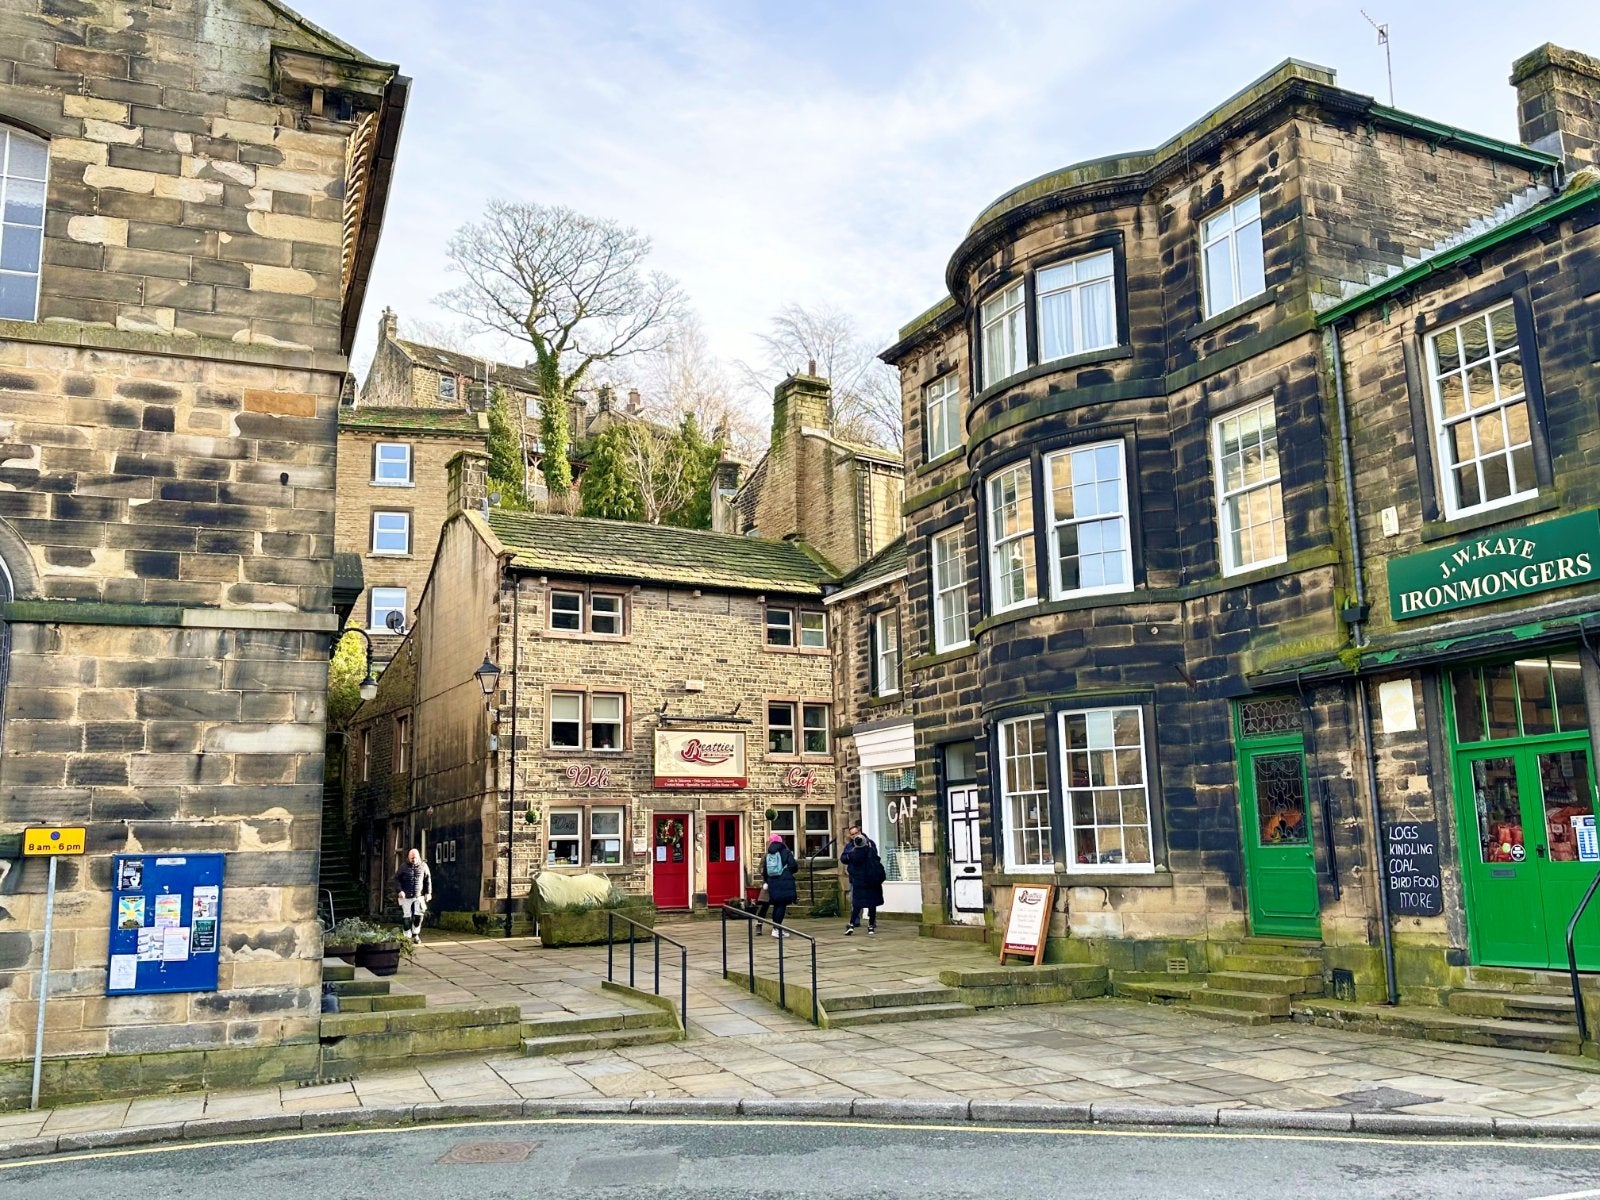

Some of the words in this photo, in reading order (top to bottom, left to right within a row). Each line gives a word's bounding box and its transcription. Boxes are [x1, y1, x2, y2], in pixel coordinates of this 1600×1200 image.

[1400, 553, 1592, 614] IRONMONGERS
[680, 738, 735, 765] Beatties
[566, 764, 612, 788] Deli
[787, 766, 818, 796] Cafe
[1389, 826, 1419, 840] LOGS
[28, 843, 35, 851] 8
[58, 842, 65, 851] 6
[1389, 843, 1434, 856] KINDLING
[1389, 859, 1420, 874] COAL
[1391, 876, 1412, 890] BIRD
[1413, 874, 1440, 888] FOOD
[1400, 892, 1435, 909] MORE
